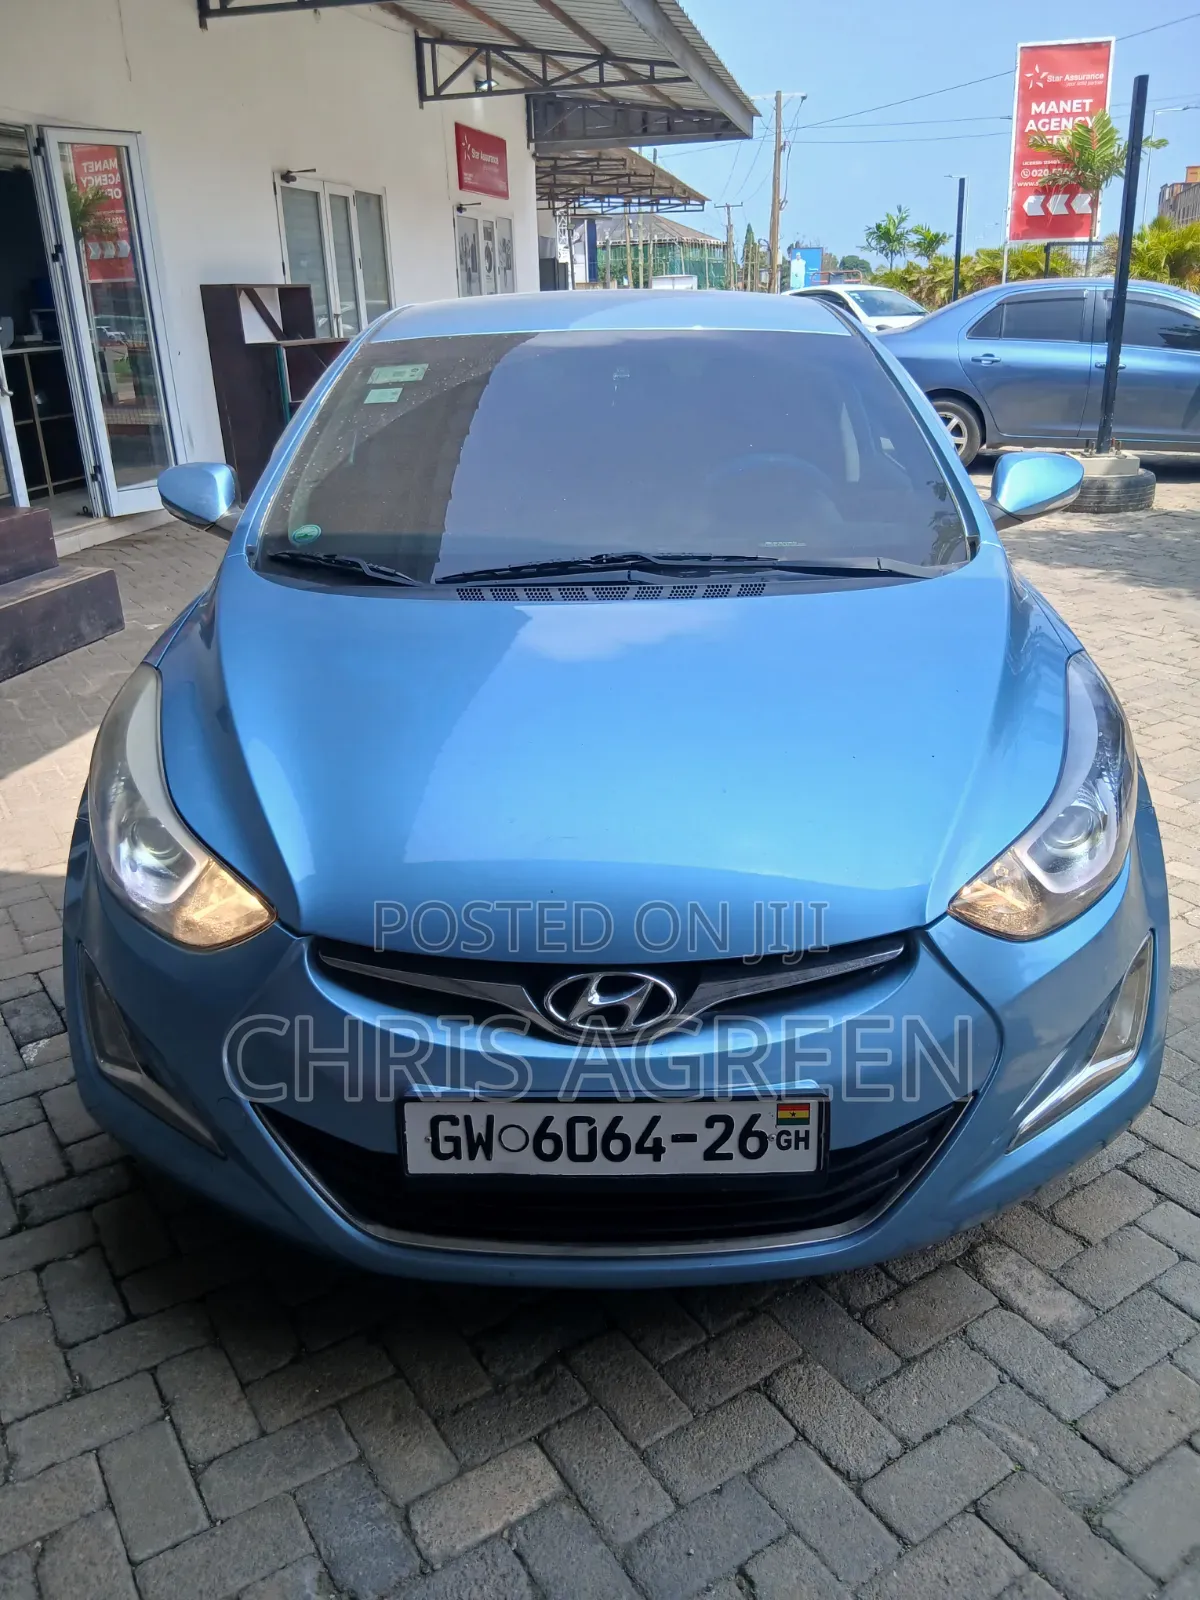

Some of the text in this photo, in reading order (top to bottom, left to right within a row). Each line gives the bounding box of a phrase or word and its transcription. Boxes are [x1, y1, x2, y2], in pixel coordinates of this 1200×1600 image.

[1064, 73, 1104, 81] Assurance
[1031, 99, 1093, 115] MANET
[430, 1112, 768, 1162] GW 6064-26
[775, 1129, 810, 1151] GH
